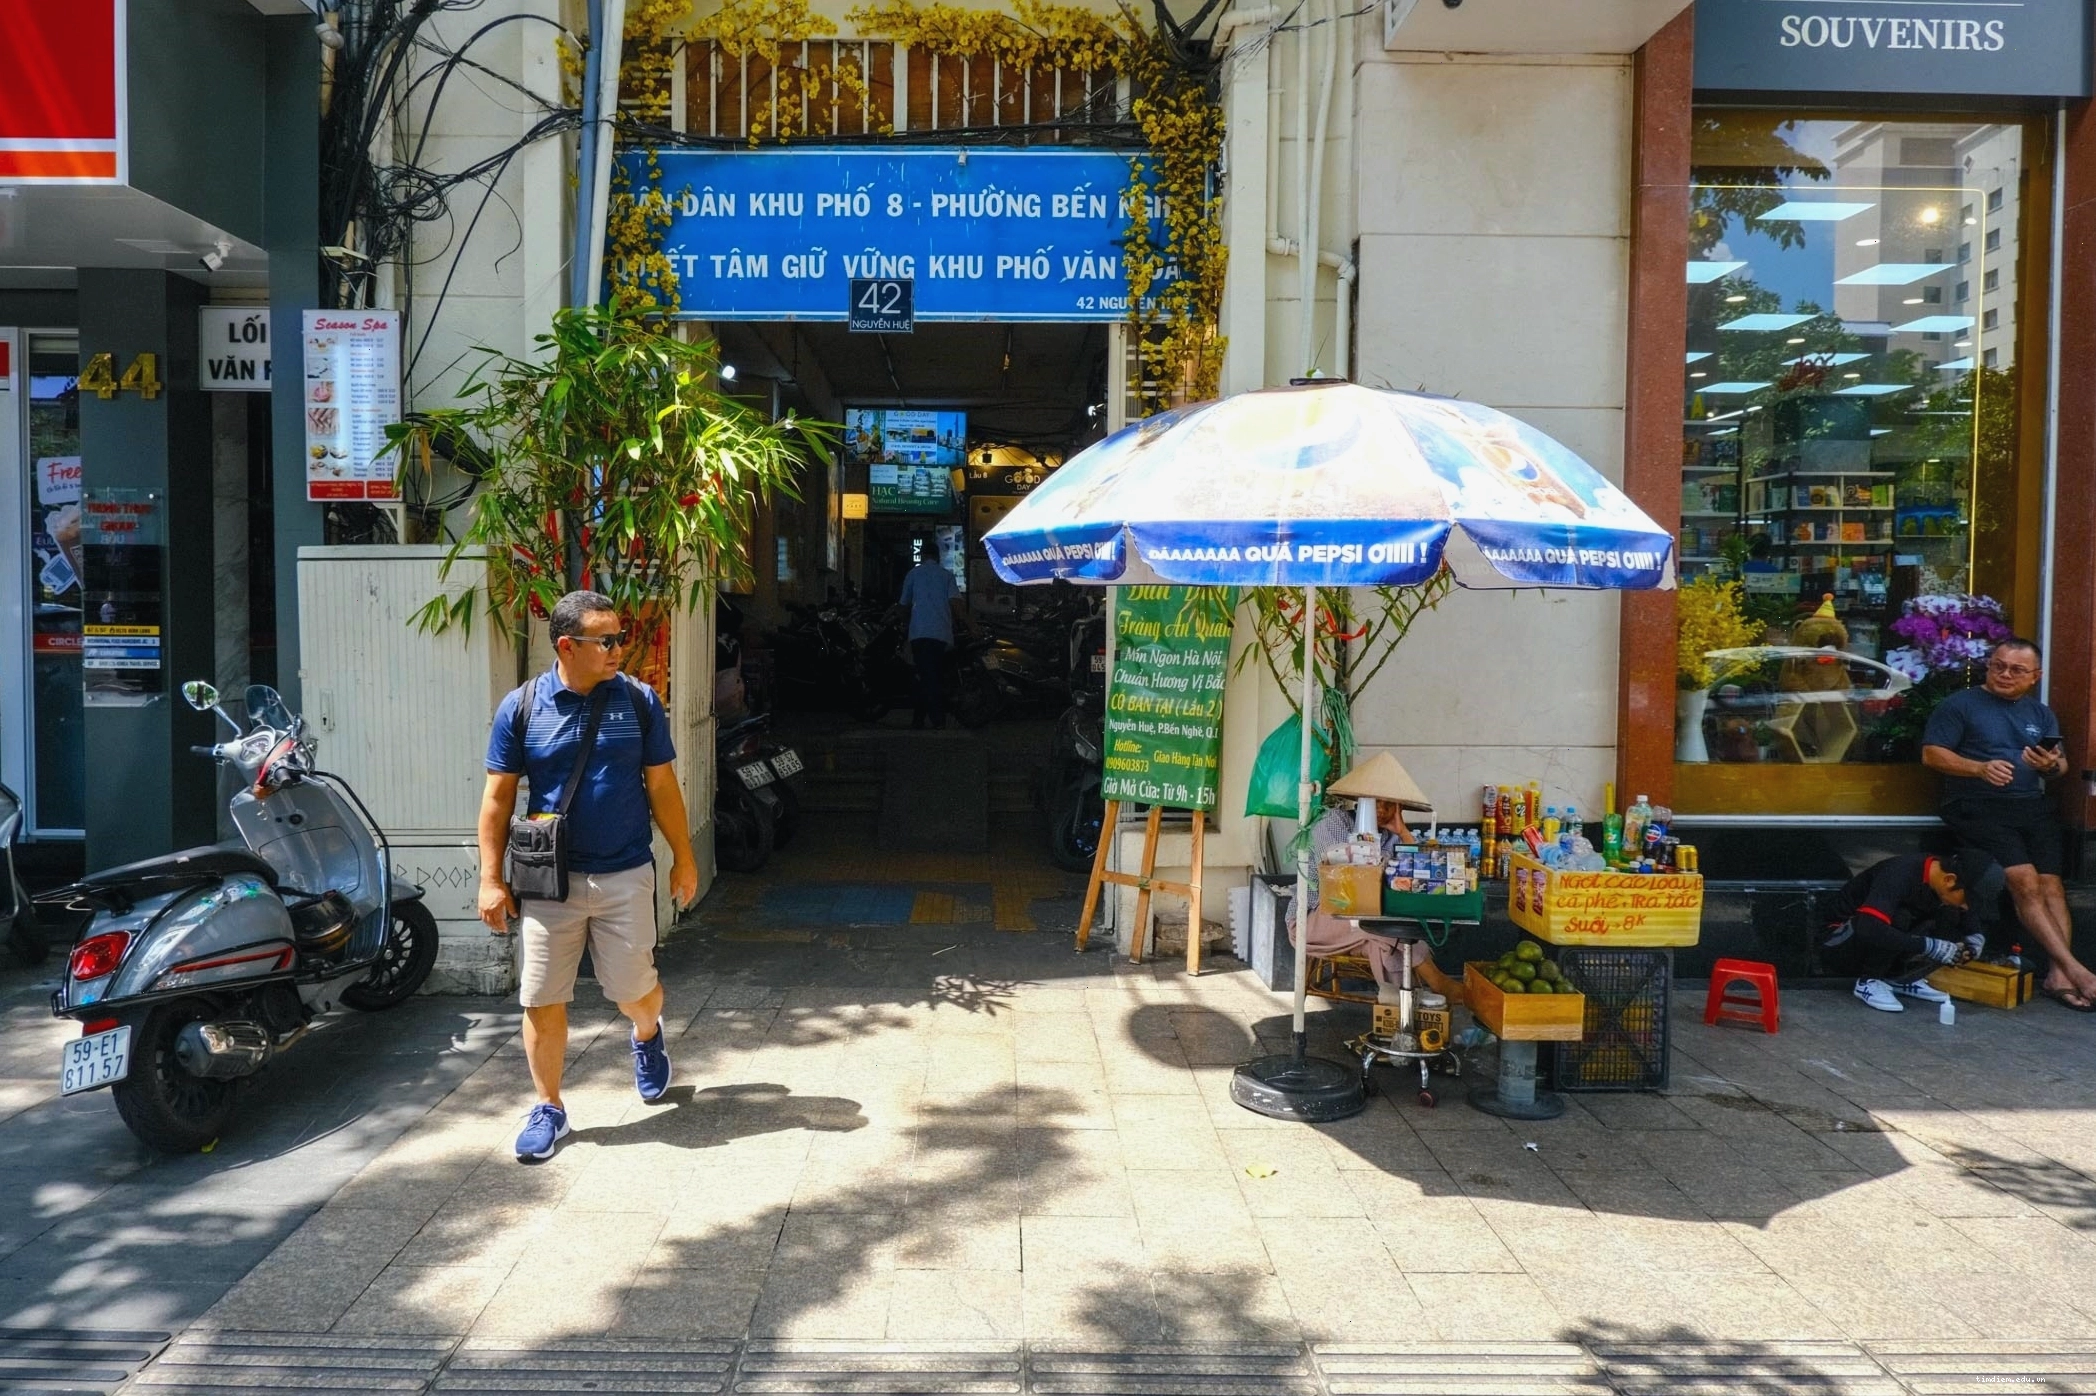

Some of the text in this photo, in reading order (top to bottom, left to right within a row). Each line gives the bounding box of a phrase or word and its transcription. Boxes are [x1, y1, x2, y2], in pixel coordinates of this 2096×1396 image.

[1780, 15, 2005, 51] SOUVENIRS
[682, 186, 736, 218] DÂN
[750, 193, 804, 218] KHU
[816, 182, 875, 218] PHỐ
[886, 193, 904, 218] 8
[931, 183, 1041, 219] PHƯỜNG
[1051, 182, 1107, 219] BẾN
[710, 247, 769, 279] TÂM
[781, 246, 828, 279] GIỮ
[843, 247, 915, 279] VỮNG
[929, 254, 983, 280] KHU
[996, 245, 1055, 280] PHỐ
[1062, 249, 1116, 280] VĂN
[858, 282, 902, 314] 42
[1076, 296, 1094, 310] 42
[229, 315, 267, 343] LỐI
[314, 318, 388, 332] Season Spa
[852, 318, 911, 330] NGUYỄN HUỆ
[78, 352, 162, 400] 44
[208, 356, 255, 380] VĂN
[47, 462, 82, 483] Free
[1064, 543, 1094, 560] PEPSI
[1245, 541, 1293, 562] QUÁ
[1298, 544, 1363, 563] PEPSI
[1544, 546, 1578, 564] QUÁ
[1579, 550, 1622, 568] PEPSI
[1118, 610, 1160, 642] Tràng
[1149, 648, 1180, 667] Ngon
[1182, 649, 1199, 665] Hà
[1202, 650, 1222, 669] Nội
[1114, 668, 1149, 687] Chuẩn
[1151, 671, 1188, 692] Hương
[1205, 672, 1225, 690] Bắc
[1111, 689, 1126, 710] CÓ
[1156, 698, 1174, 718] TẠI
[1182, 697, 1204, 716] Lầu
[1207, 700, 1216, 717] 2
[1109, 718, 1136, 733] Nguyễn
[1114, 739, 1142, 753] Hotline:
[1153, 750, 1170, 763] Giao
[1172, 752, 1191, 769] Hàng
[1103, 777, 1117, 794] Giờ
[1120, 778, 1136, 796] Mở
[1162, 783, 1175, 800] Từ
[1176, 785, 1187, 802] 9h
[1196, 786, 1215, 805] 15h
[1417, 1011, 1441, 1021] TOYS
[73, 1033, 117, 1064] 59-E1
